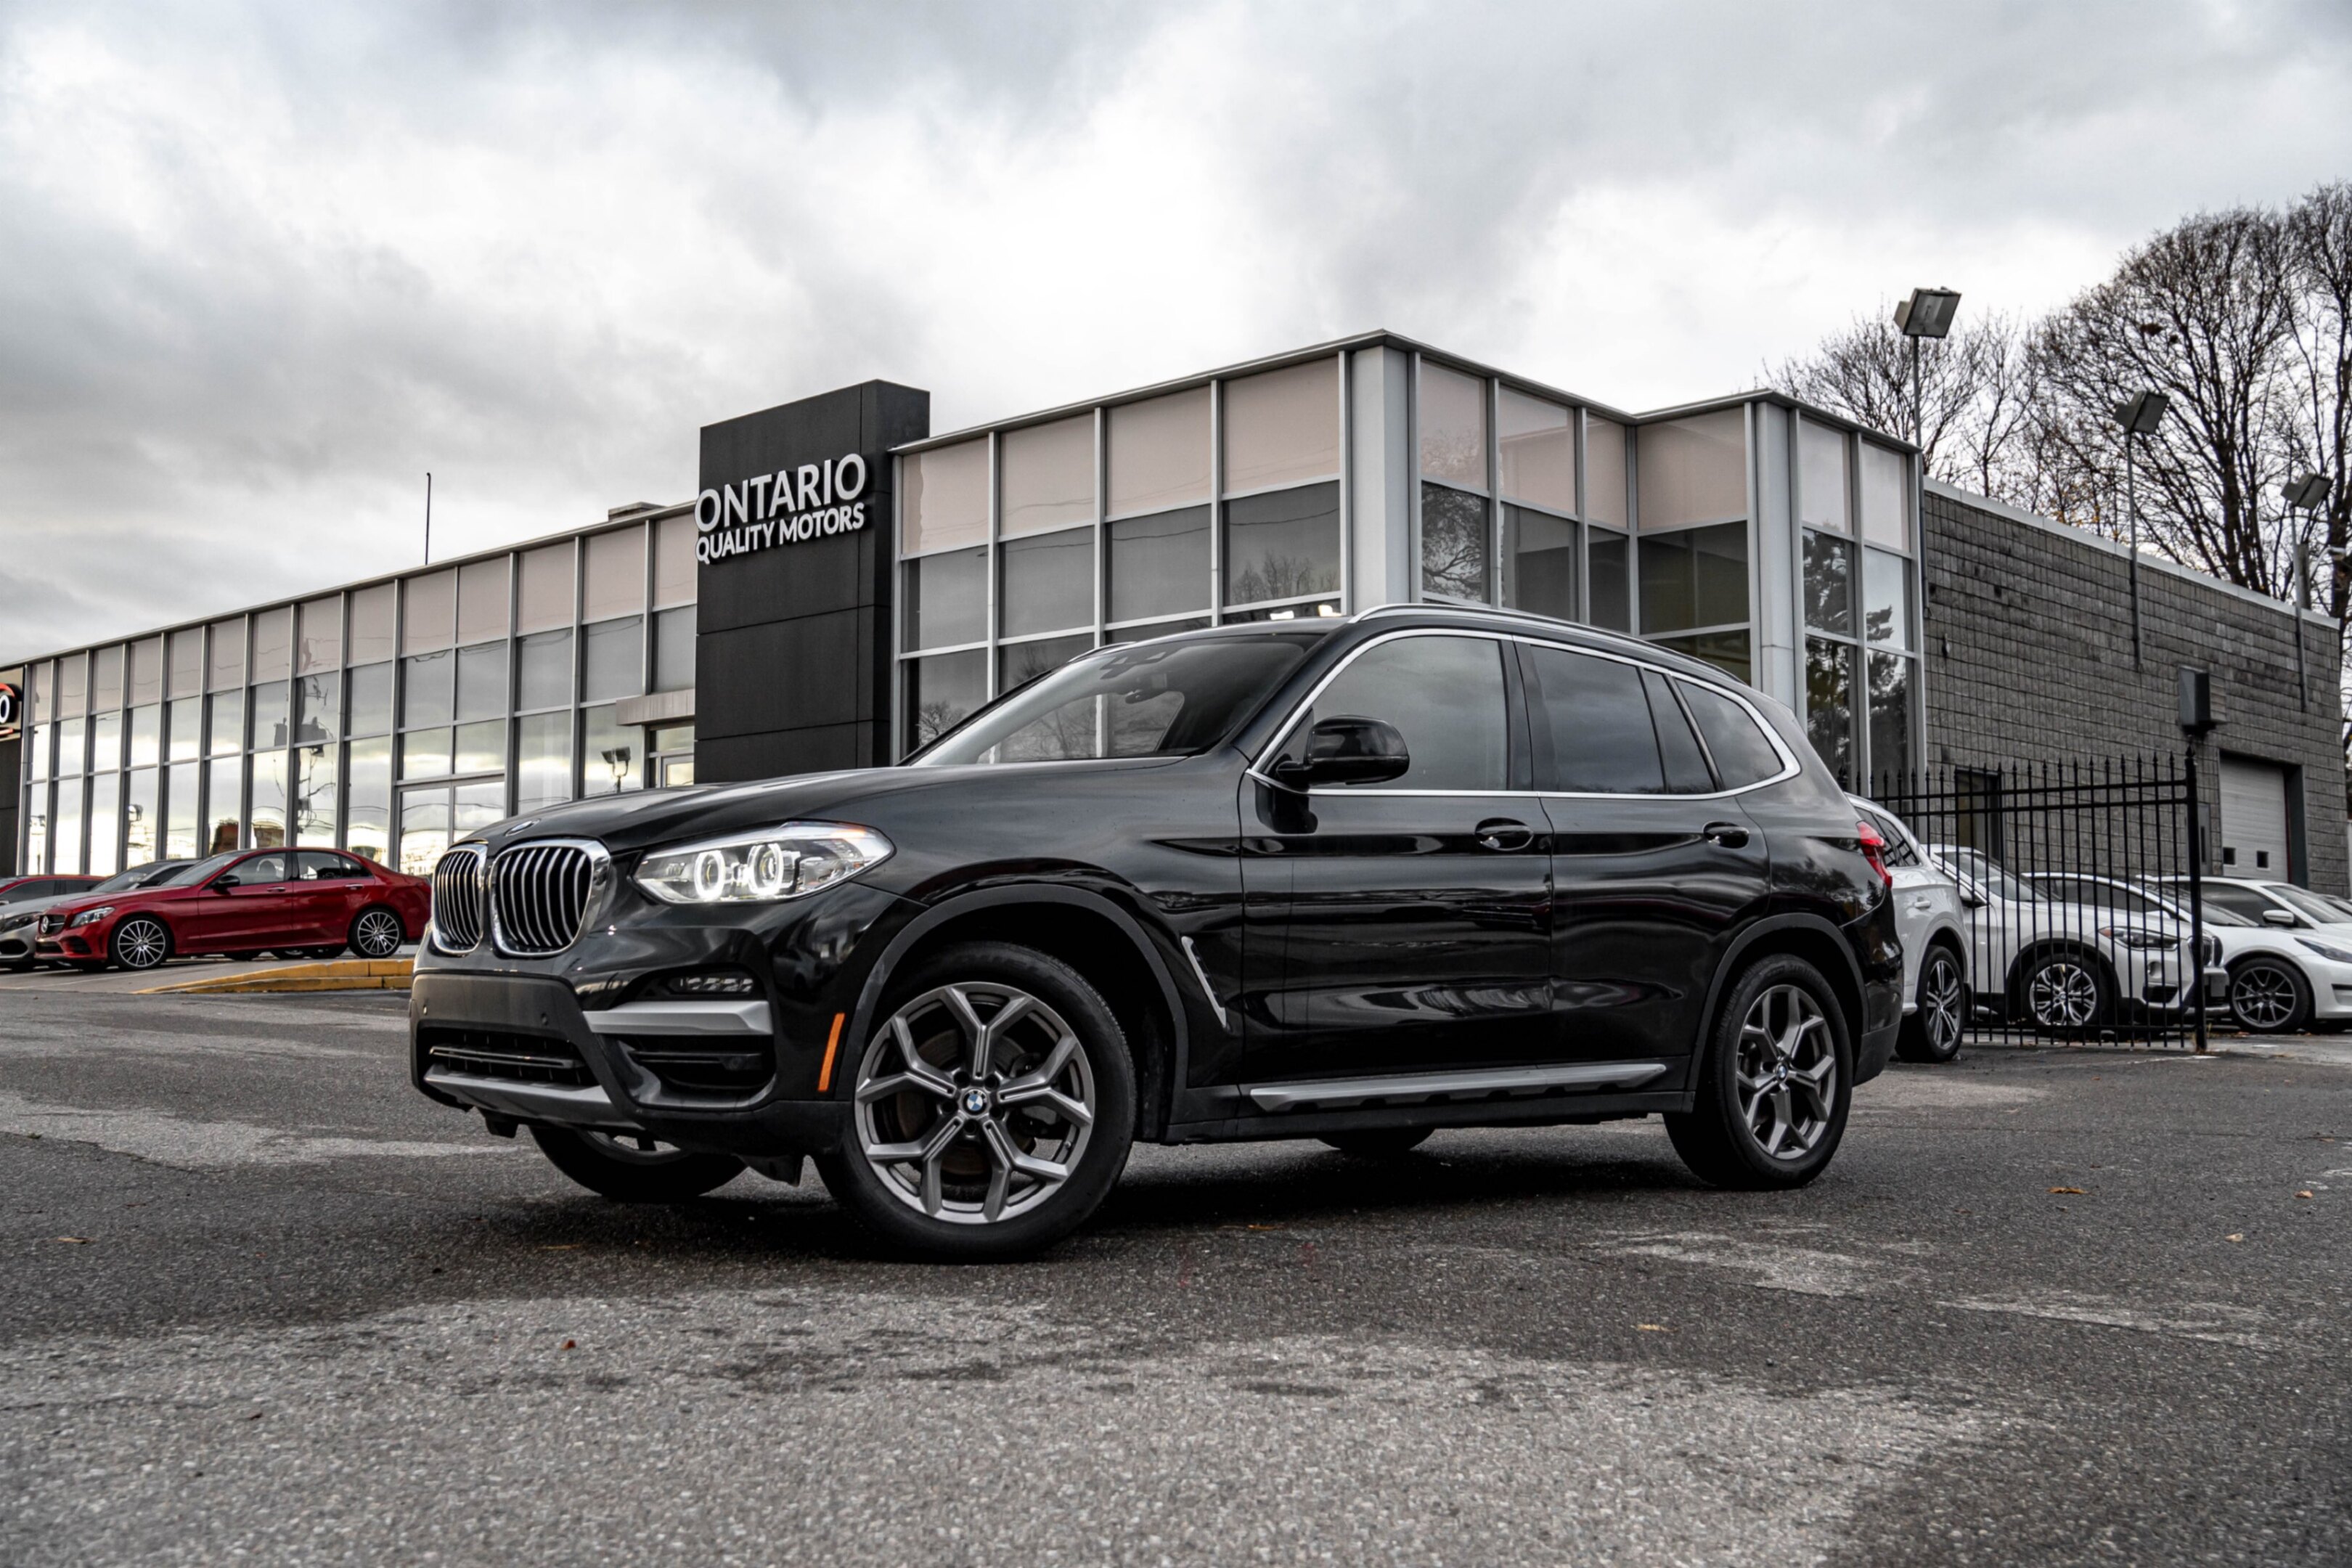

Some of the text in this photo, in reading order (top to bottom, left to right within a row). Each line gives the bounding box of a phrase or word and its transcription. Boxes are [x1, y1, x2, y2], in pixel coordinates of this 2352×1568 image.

[695, 453, 866, 531] ONTARIO
[695, 502, 865, 564] QUALITY MOTORS
